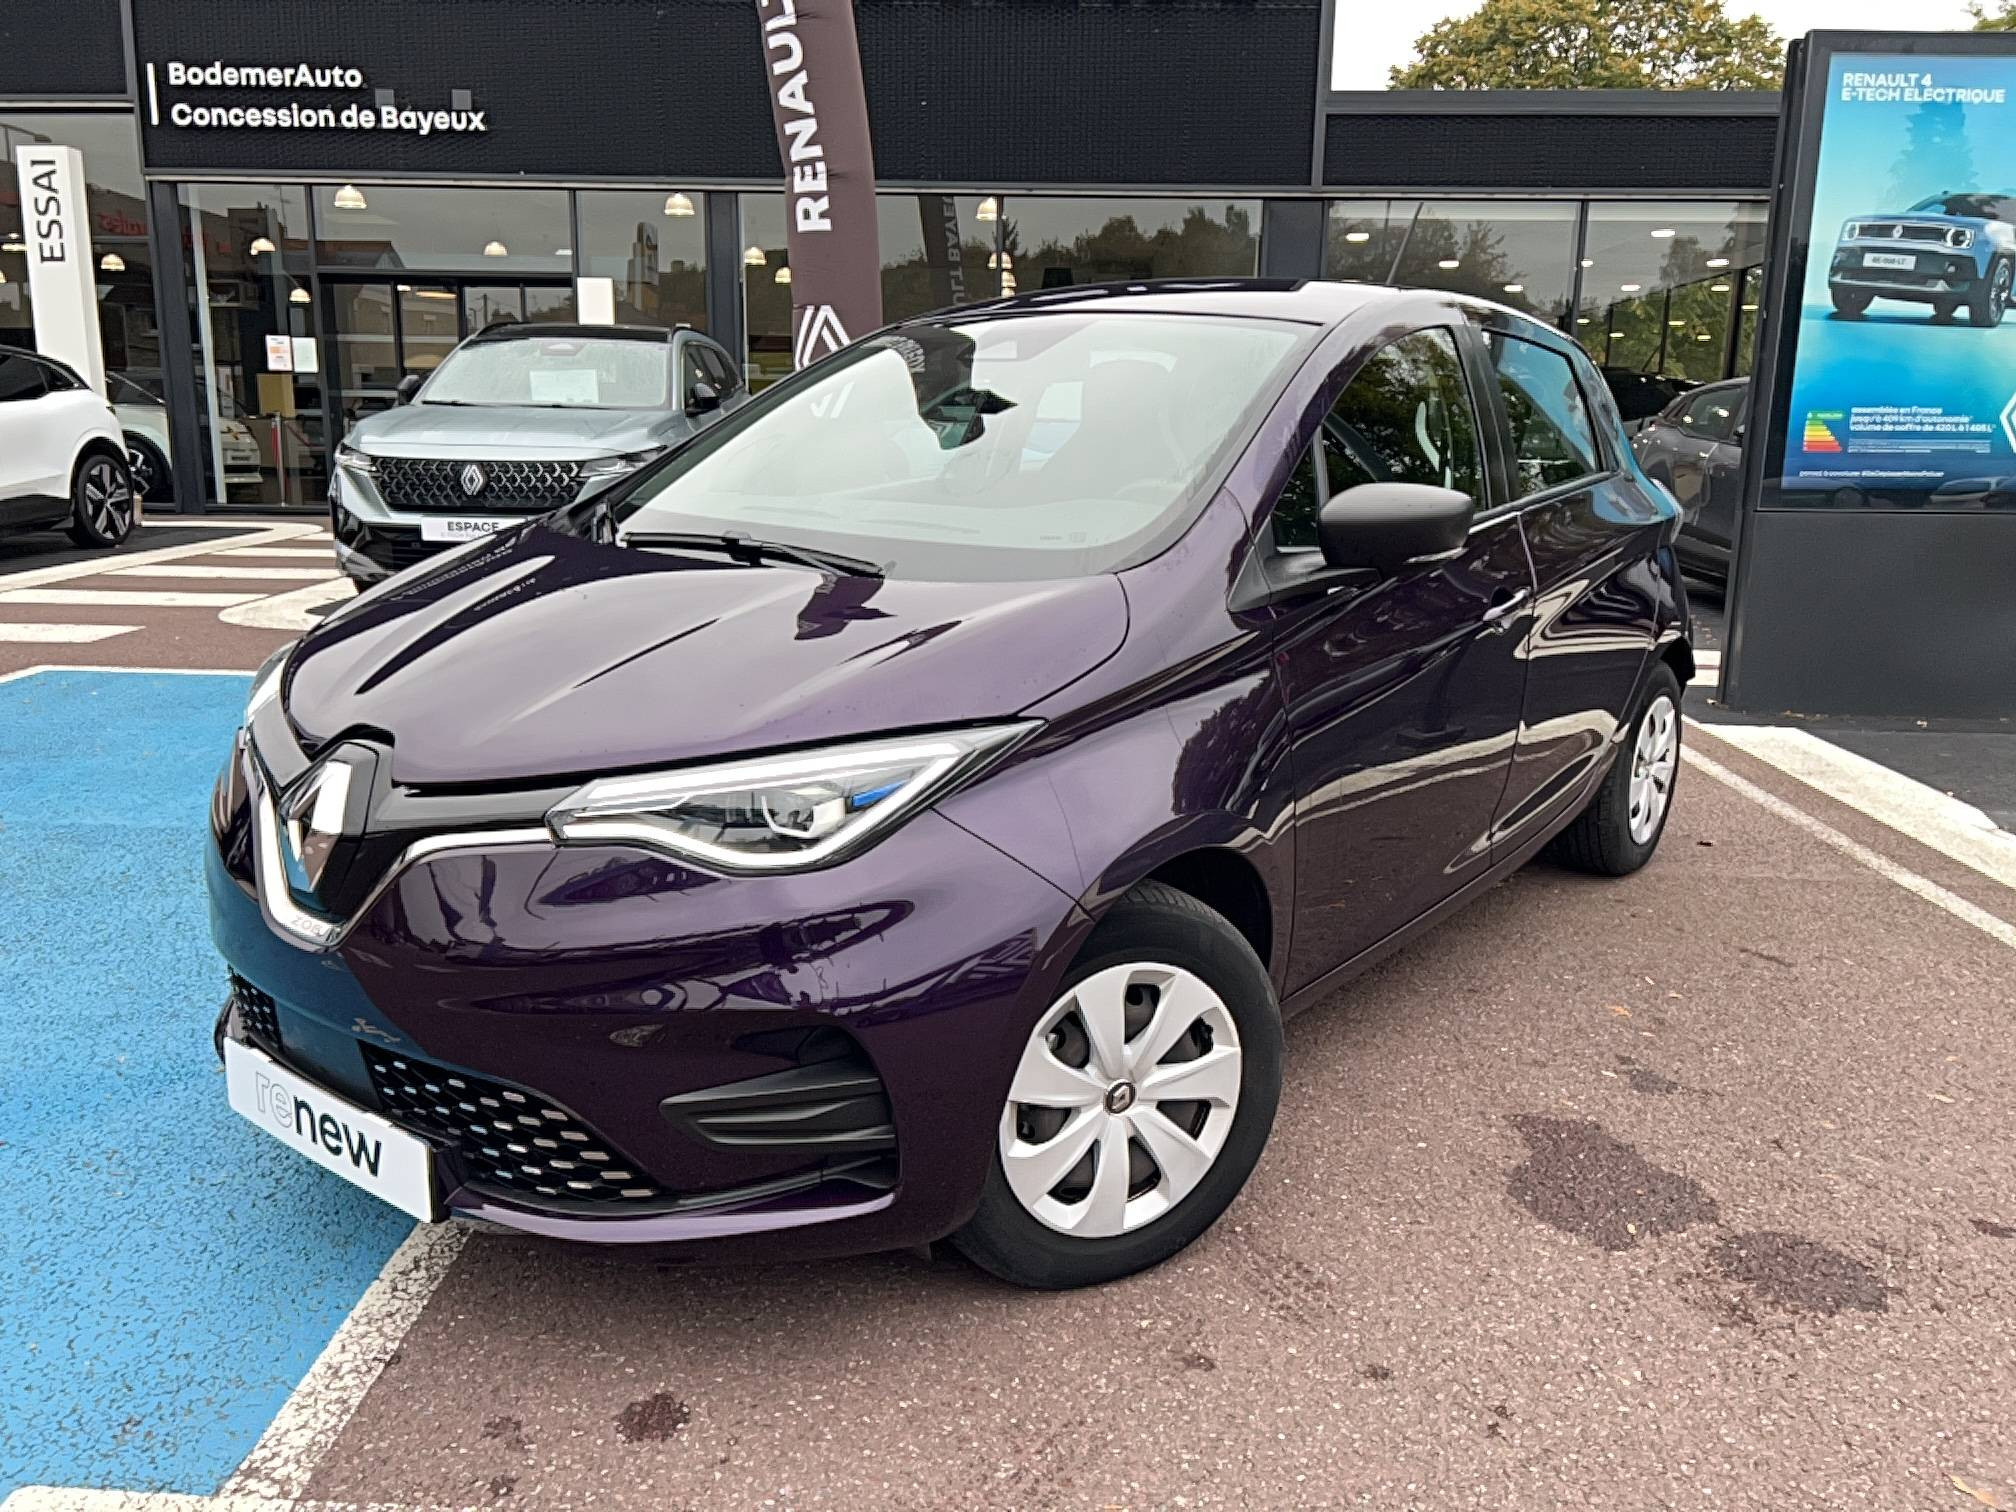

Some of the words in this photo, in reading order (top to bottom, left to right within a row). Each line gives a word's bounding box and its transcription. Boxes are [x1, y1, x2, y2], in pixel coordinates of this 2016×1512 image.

[167, 61, 364, 88] BodemerAuto
[1842, 72, 1919, 88] RENAULT
[1920, 73, 1932, 87] 4
[1841, 87, 1902, 102] E-TECH
[1903, 88, 2006, 104] ELECTRIQUE
[171, 102, 336, 127] Concession
[340, 104, 376, 129] de
[381, 106, 486, 135] Bayeux
[761, 0, 832, 232] RENAUL
[30, 159, 66, 264] ESSAI
[447, 521, 500, 532] ESPACE
[255, 1071, 382, 1177] renew
